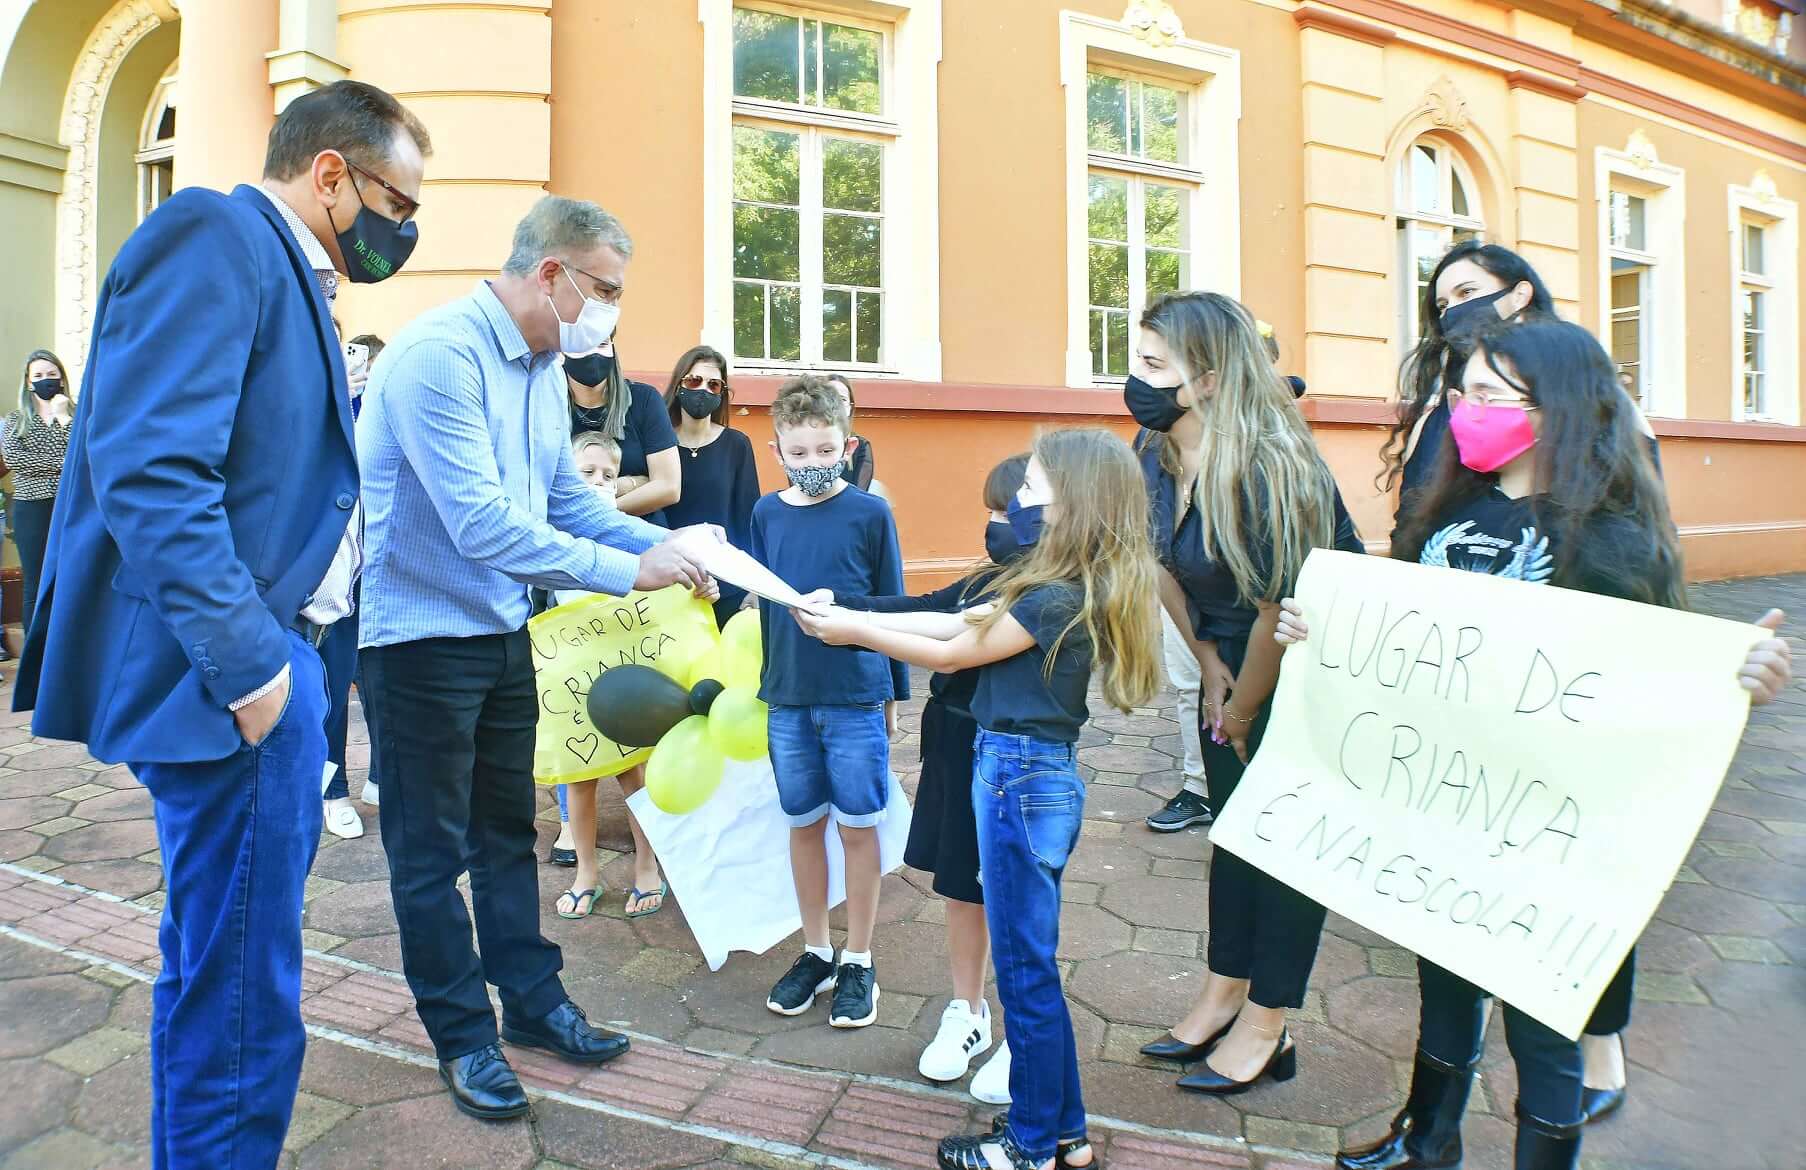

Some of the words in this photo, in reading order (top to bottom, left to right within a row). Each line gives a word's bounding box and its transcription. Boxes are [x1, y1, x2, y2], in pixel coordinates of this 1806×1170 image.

[354, 239, 366, 254] Dr.
[530, 618, 606, 672] UGAR
[613, 596, 651, 632] DE
[1318, 589, 1483, 703] LUGAR
[1515, 648, 1602, 723] DE
[1255, 782, 1311, 842] É
[1339, 711, 1581, 865] CRIANÇA
